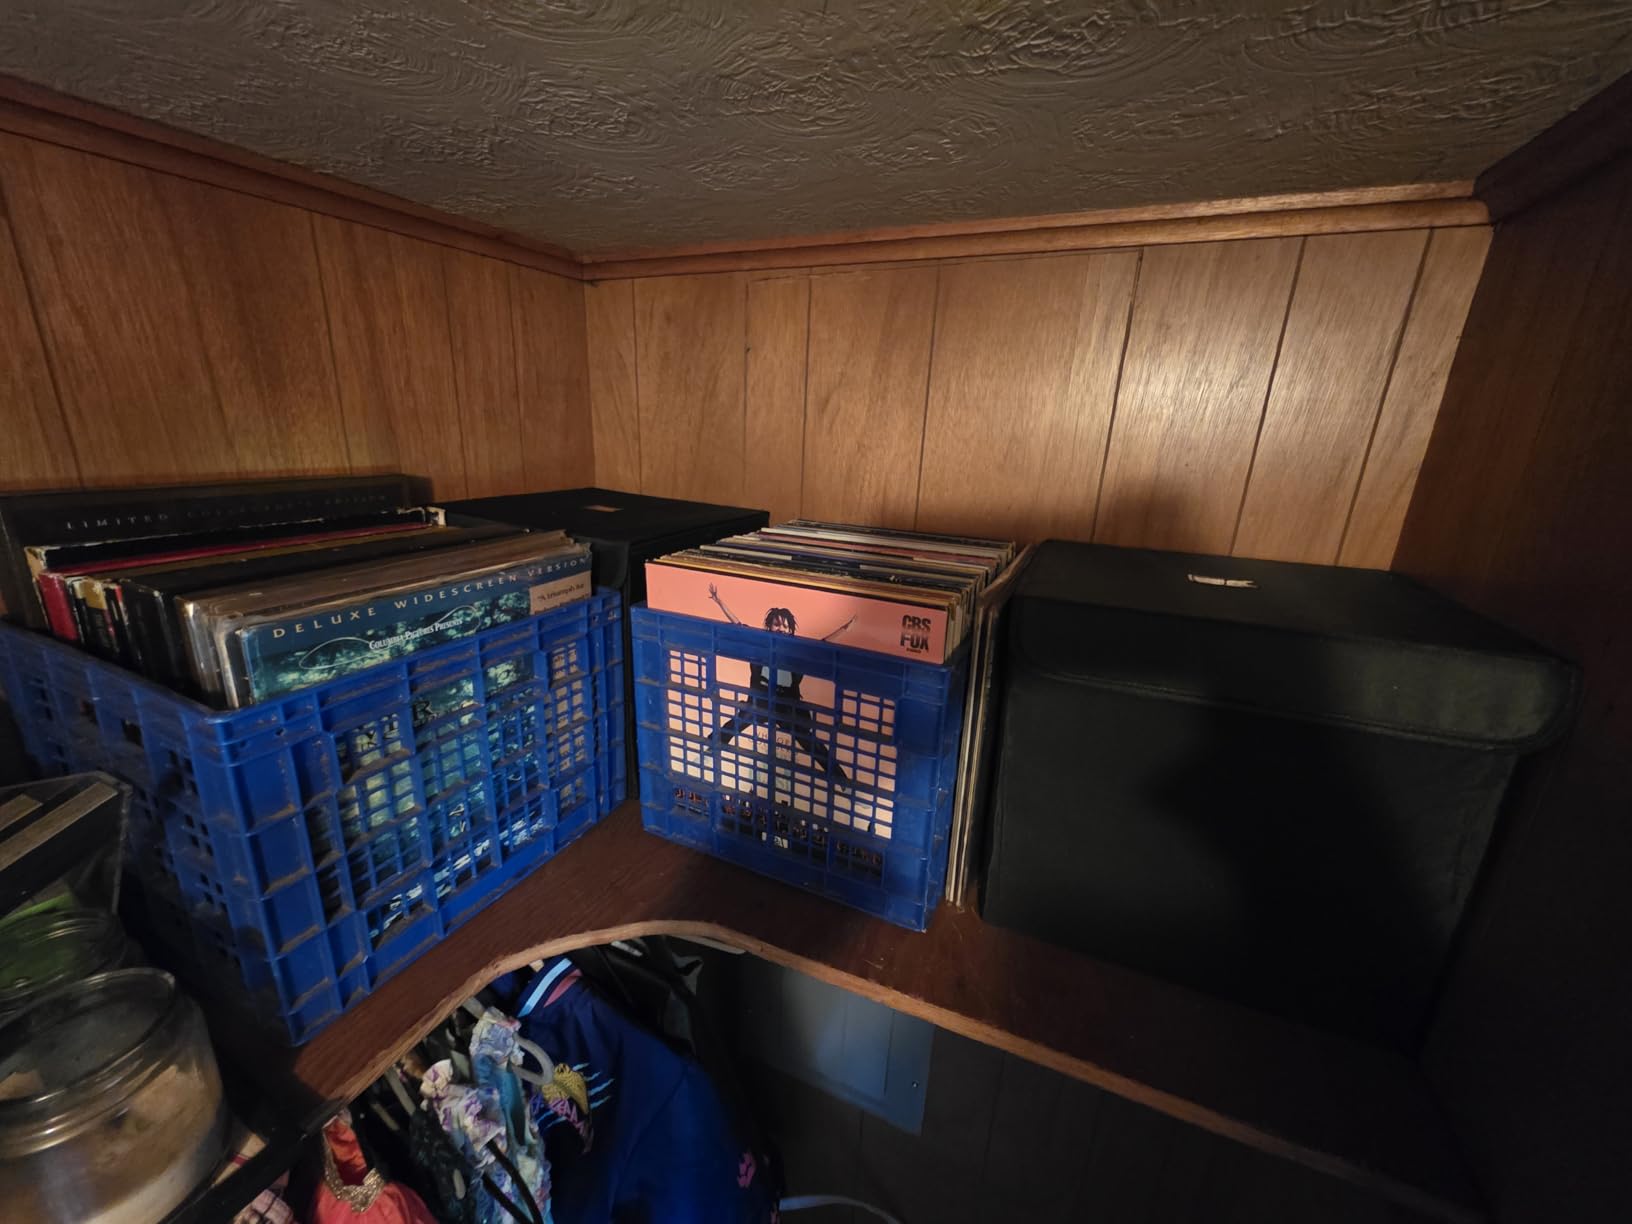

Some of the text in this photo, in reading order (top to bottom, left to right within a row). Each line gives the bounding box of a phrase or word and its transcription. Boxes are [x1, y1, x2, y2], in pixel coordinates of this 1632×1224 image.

[65, 513, 169, 530] LIMITED
[272, 556, 588, 638] DELUXE WIDESCREEN VERSION
[902, 614, 931, 632] CBS
[900, 631, 930, 651] FOX
